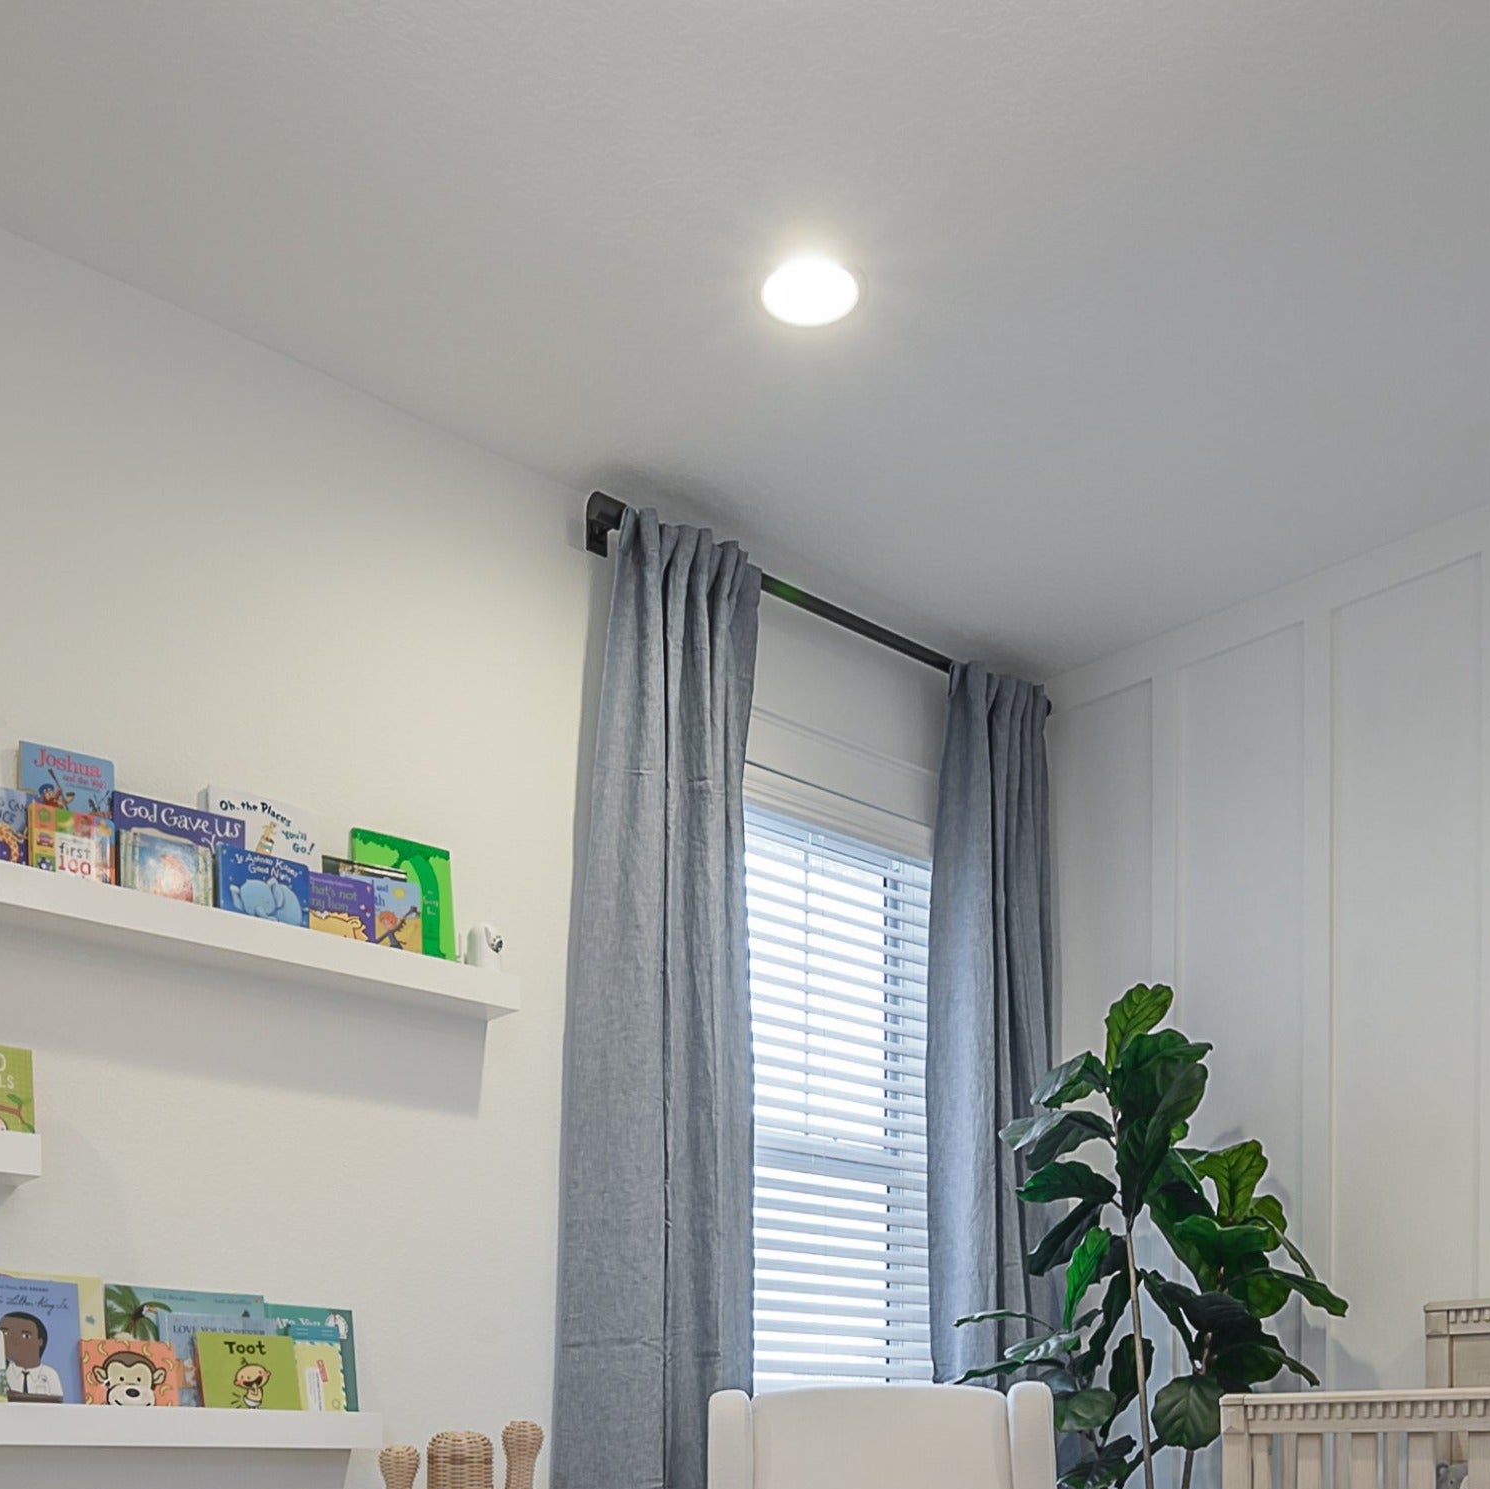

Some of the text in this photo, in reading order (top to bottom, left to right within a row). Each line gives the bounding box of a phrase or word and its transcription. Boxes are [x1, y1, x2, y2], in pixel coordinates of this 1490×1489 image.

[34, 749, 102, 778] Joshua
[8, 799, 27, 813] CAN
[241, 801, 258, 812] the
[260, 802, 293, 827] Places
[120, 799, 241, 839] God Gave Us
[59, 842, 91, 859] first
[292, 842, 316, 855] Go!
[58, 856, 92, 876] 100
[172, 1324, 197, 1335] LOVE
[224, 1340, 267, 1356] Toot
